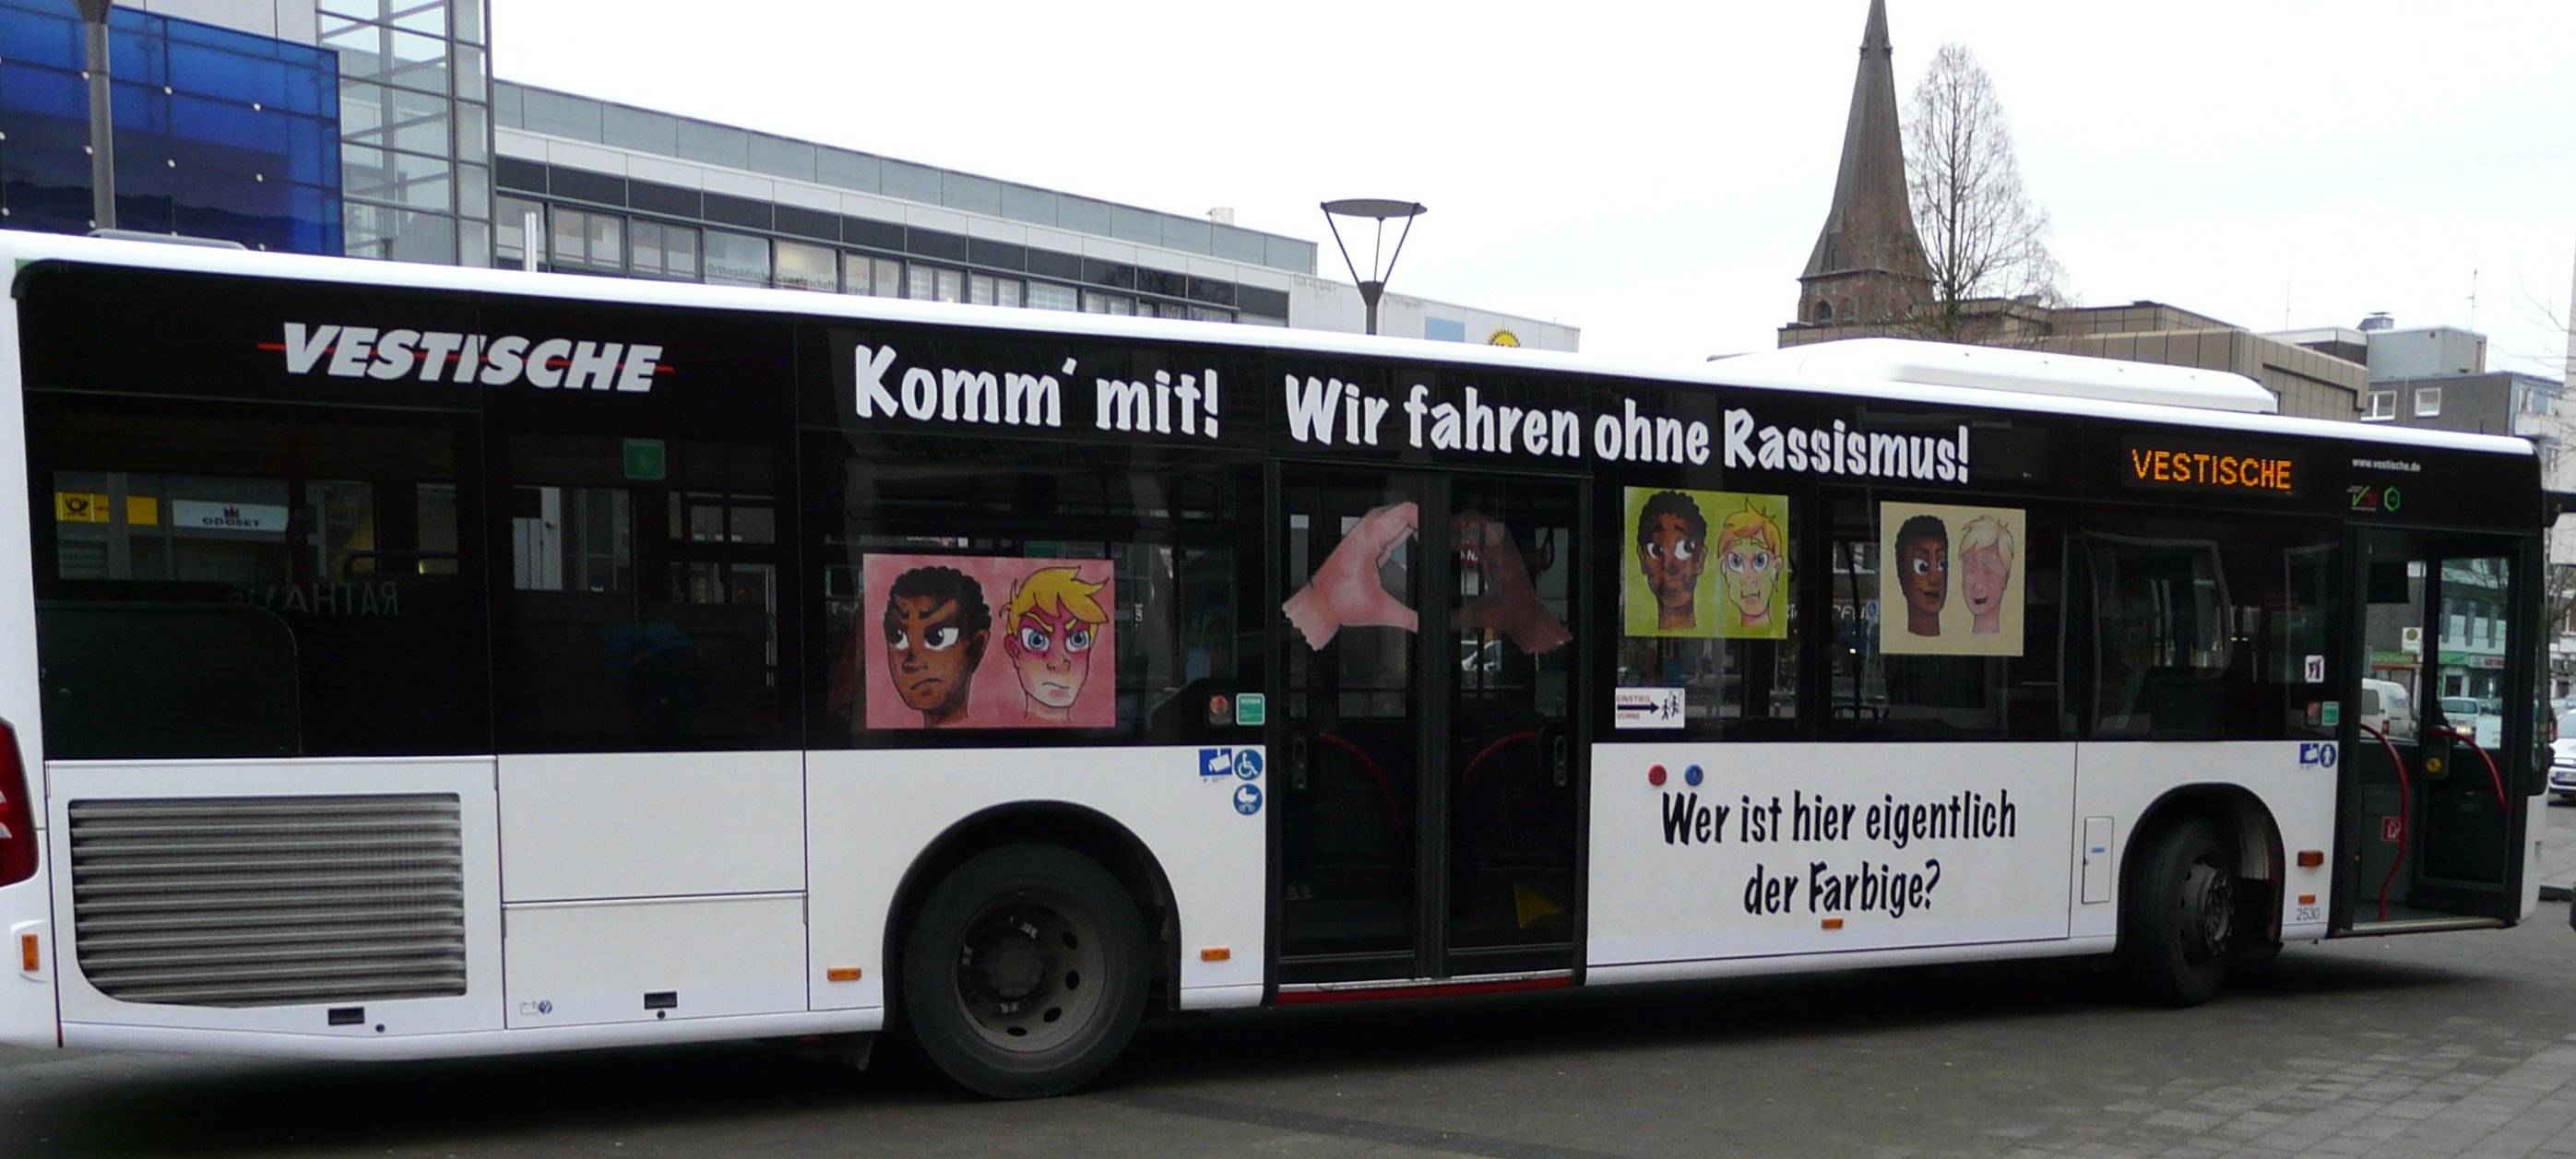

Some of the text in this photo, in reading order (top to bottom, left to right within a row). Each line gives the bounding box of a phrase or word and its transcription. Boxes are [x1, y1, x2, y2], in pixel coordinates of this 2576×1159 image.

[283, 322, 663, 393] VESTISCHE
[1096, 369, 1218, 439] mit!
[1285, 373, 1389, 445] Wir
[1403, 384, 1580, 457] fahren
[1594, 397, 1710, 465] ohne
[1724, 407, 1969, 484] Rassismus!
[2131, 448, 2293, 490] VESTISCHE
[2352, 458, 2421, 472] www.vestische.de
[1662, 788, 2016, 849] Wer ist hier eigentlich
[1743, 859, 1941, 918] der Farbige?
[2296, 907, 2320, 921] 2530
